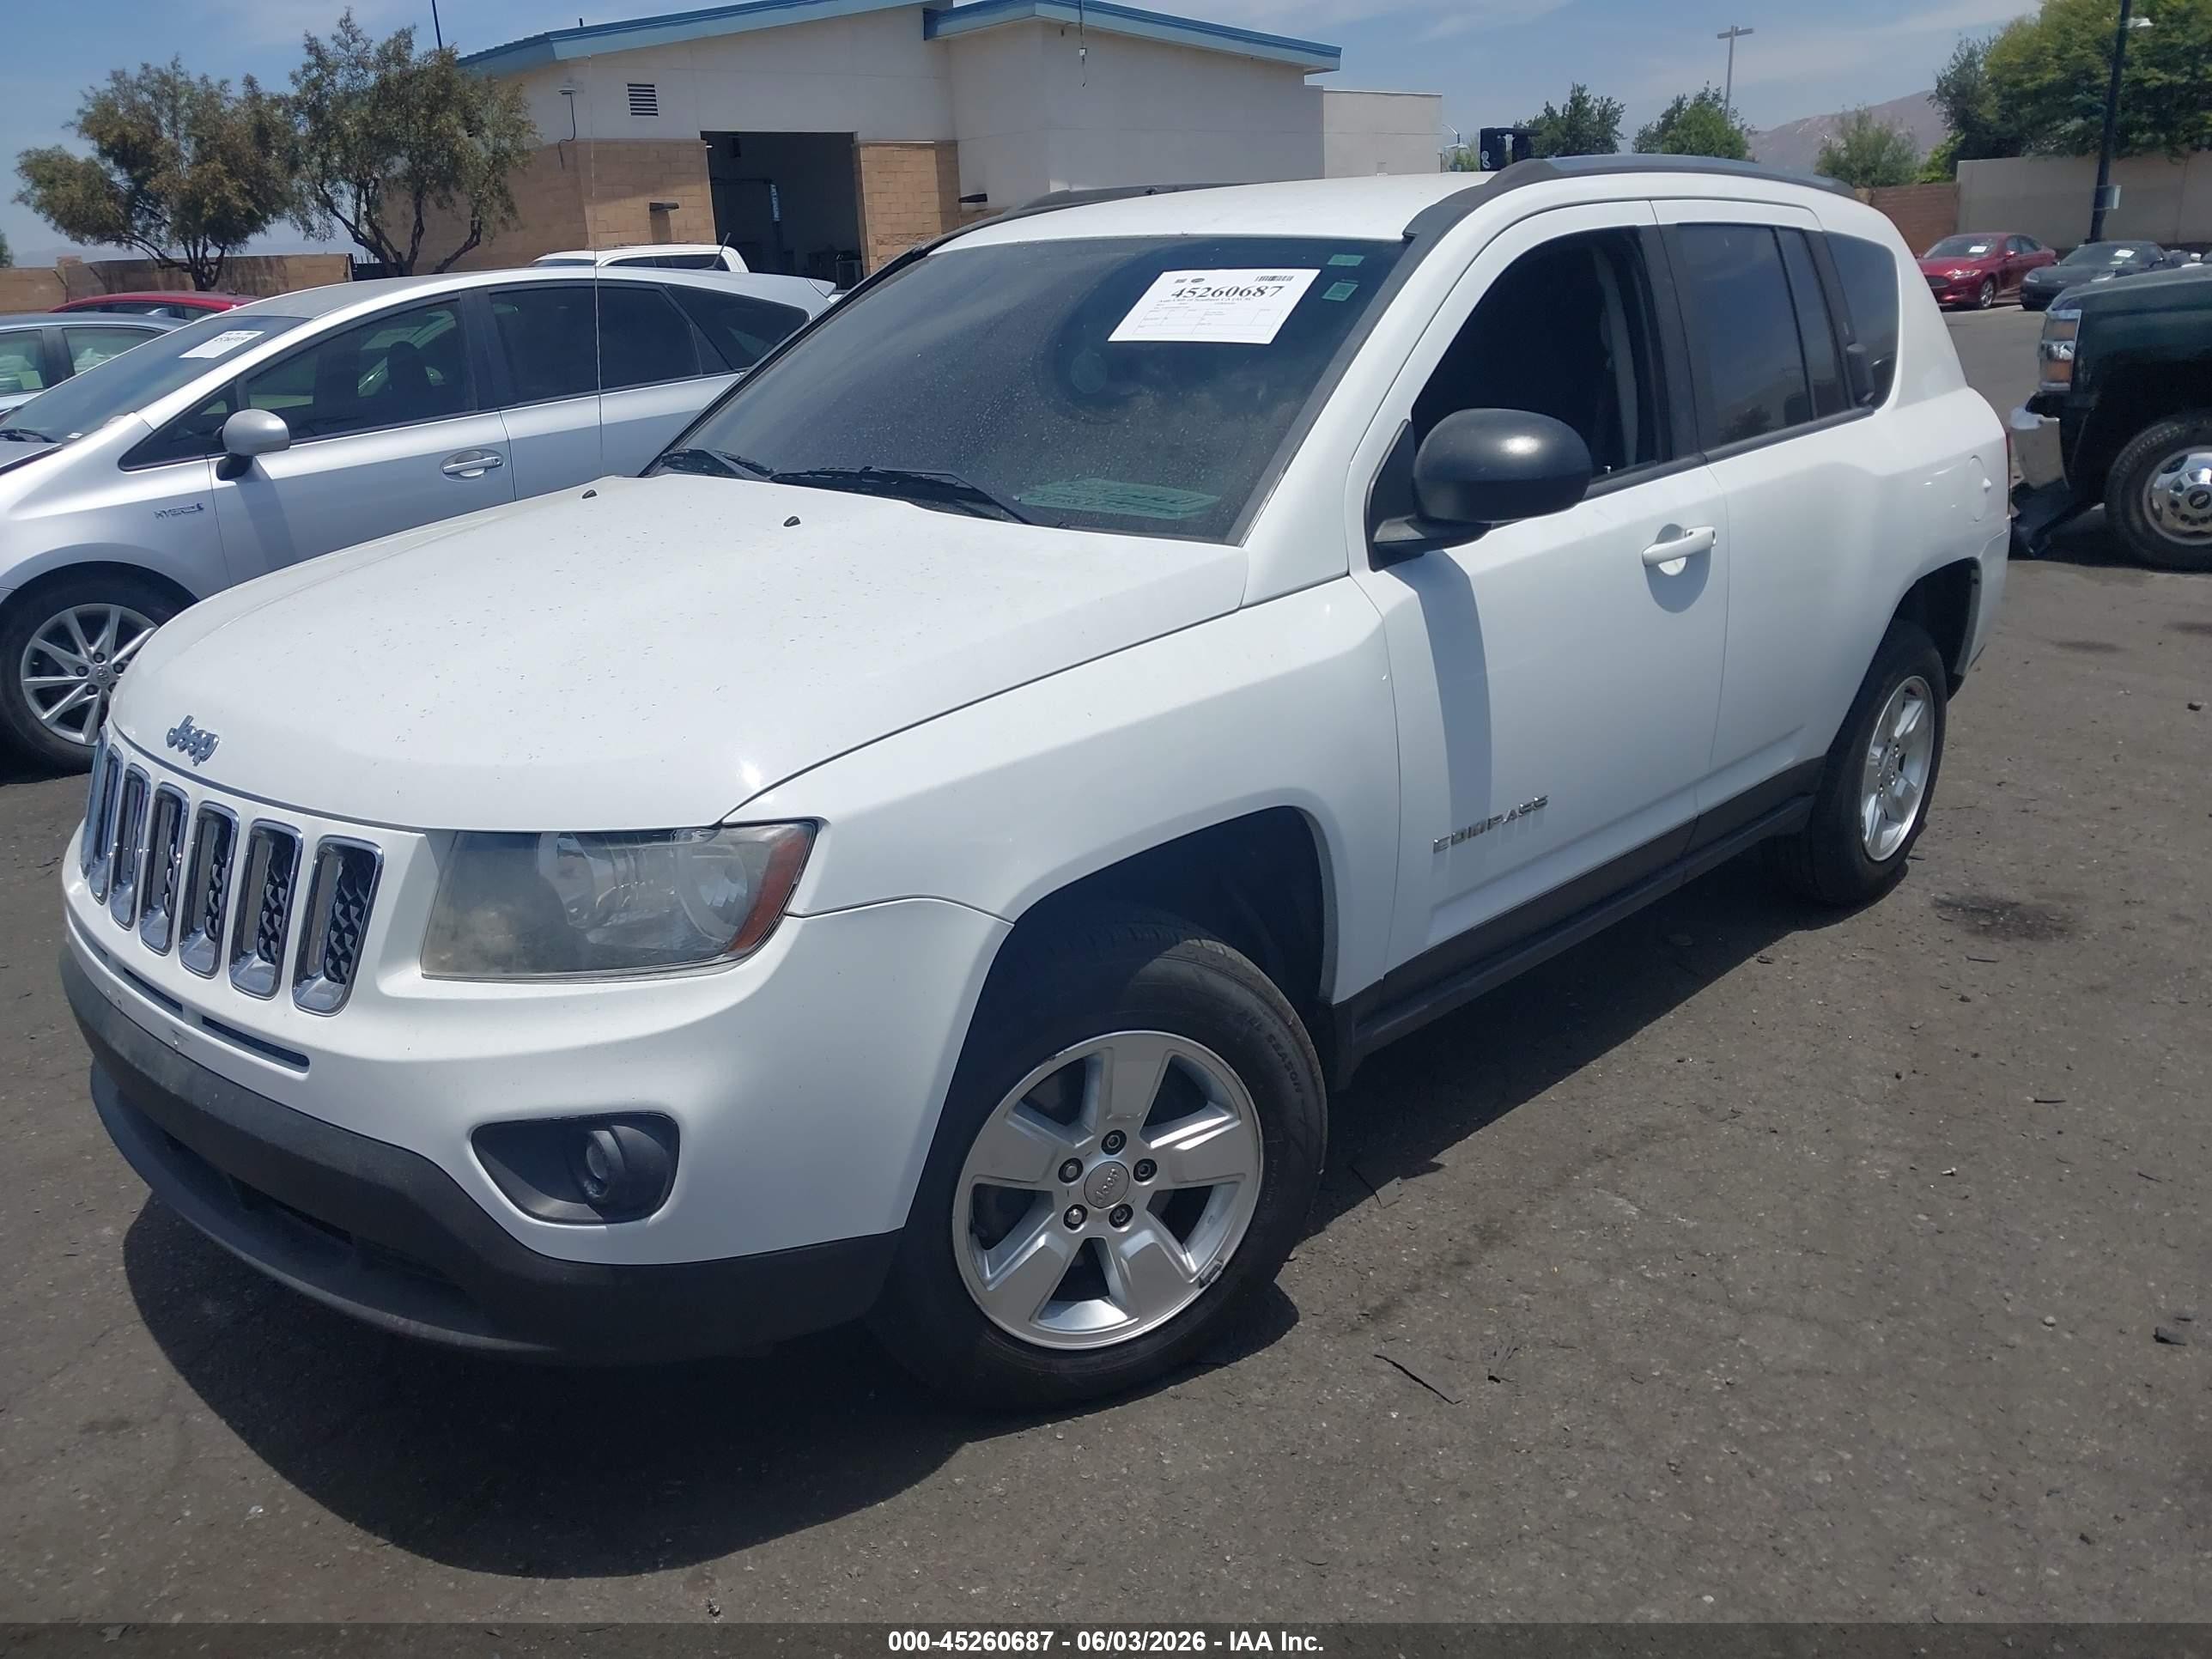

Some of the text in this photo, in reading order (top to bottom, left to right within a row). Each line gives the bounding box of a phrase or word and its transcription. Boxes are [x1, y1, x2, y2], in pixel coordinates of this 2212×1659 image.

[1170, 285, 1285, 298] 45260687
[166, 714, 220, 767] Jeep
[1432, 795, 1549, 854] COMPASS
[1095, 1167, 1120, 1204] Jeep
